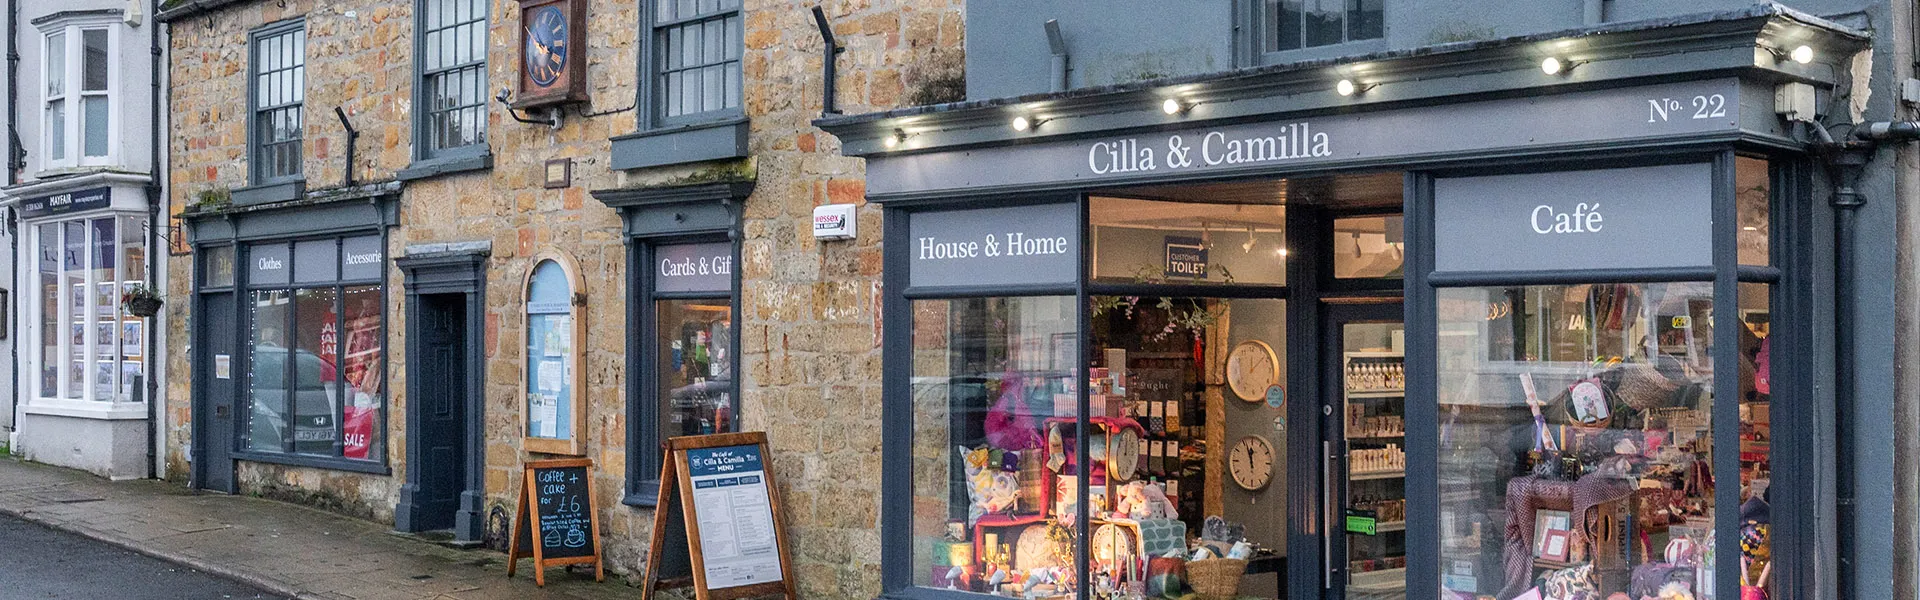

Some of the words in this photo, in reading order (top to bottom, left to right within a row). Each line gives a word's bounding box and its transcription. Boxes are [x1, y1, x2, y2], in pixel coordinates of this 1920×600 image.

[1692, 94, 1726, 119] 22
[1089, 138, 1156, 174] Cilla
[1166, 134, 1192, 169] &
[1201, 123, 1332, 166] Camilla
[50, 194, 72, 206] MAYFAIR
[1530, 202, 1603, 234] Café
[919, 236, 978, 260] House
[984, 234, 1001, 256] &
[1006, 232, 1067, 255] Home
[258, 256, 282, 270] Clothes
[346, 250, 382, 264] Accessorie
[1171, 253, 1200, 262] CUSTOMER
[662, 257, 696, 276] Cards
[698, 256, 709, 275] &
[712, 255, 732, 275] Gif
[1171, 262, 1206, 275] TOILET
[344, 432, 364, 448] SALE
[544, 484, 565, 495] cake
